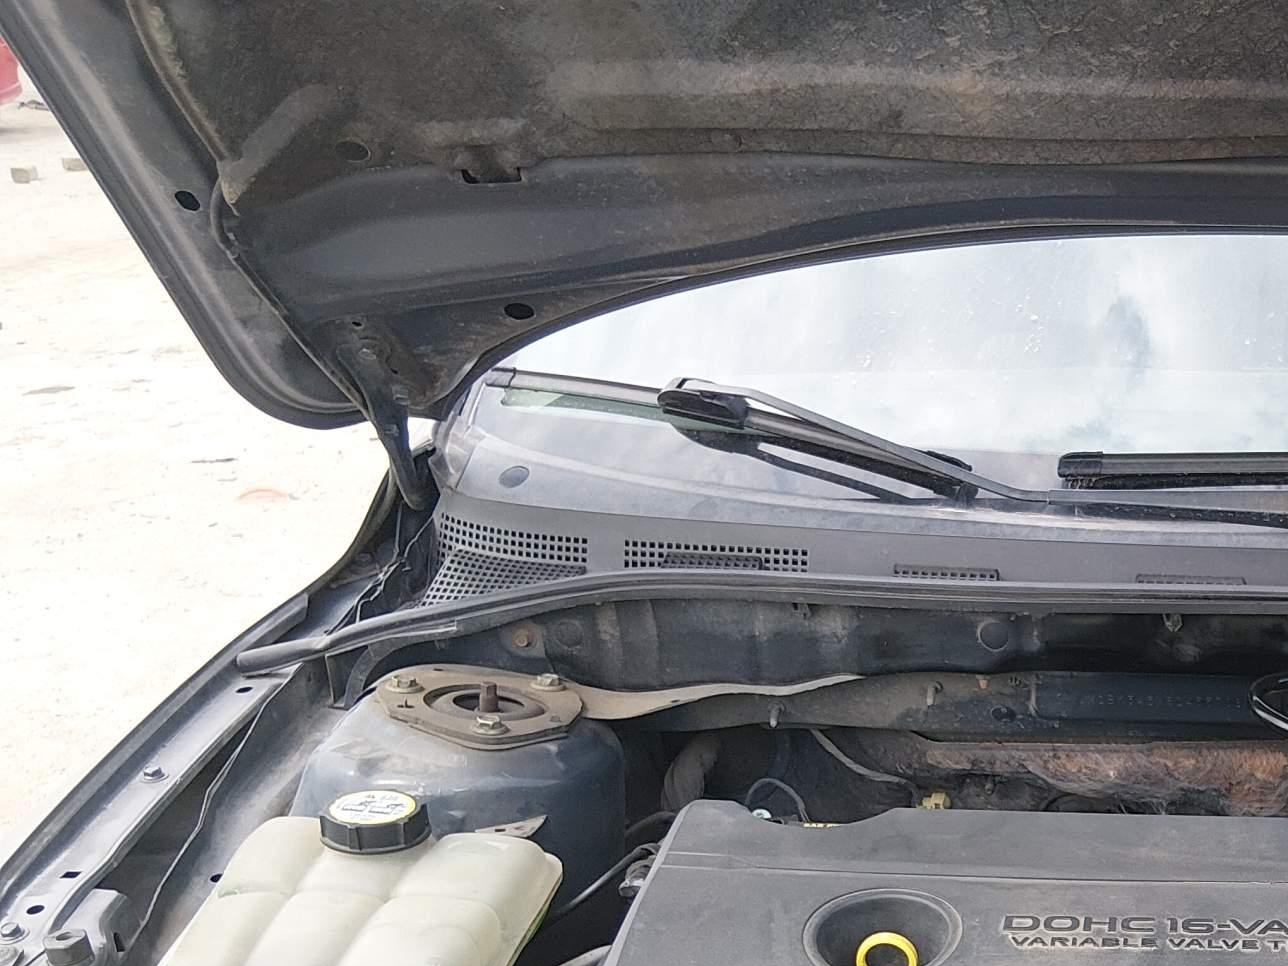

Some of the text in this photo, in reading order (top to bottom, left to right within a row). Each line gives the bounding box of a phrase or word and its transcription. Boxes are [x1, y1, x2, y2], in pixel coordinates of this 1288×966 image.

[1002, 915, 1156, 933] DOHC
[1011, 936, 1158, 948] VARIABLE
[1168, 938, 1259, 950] VALVE
